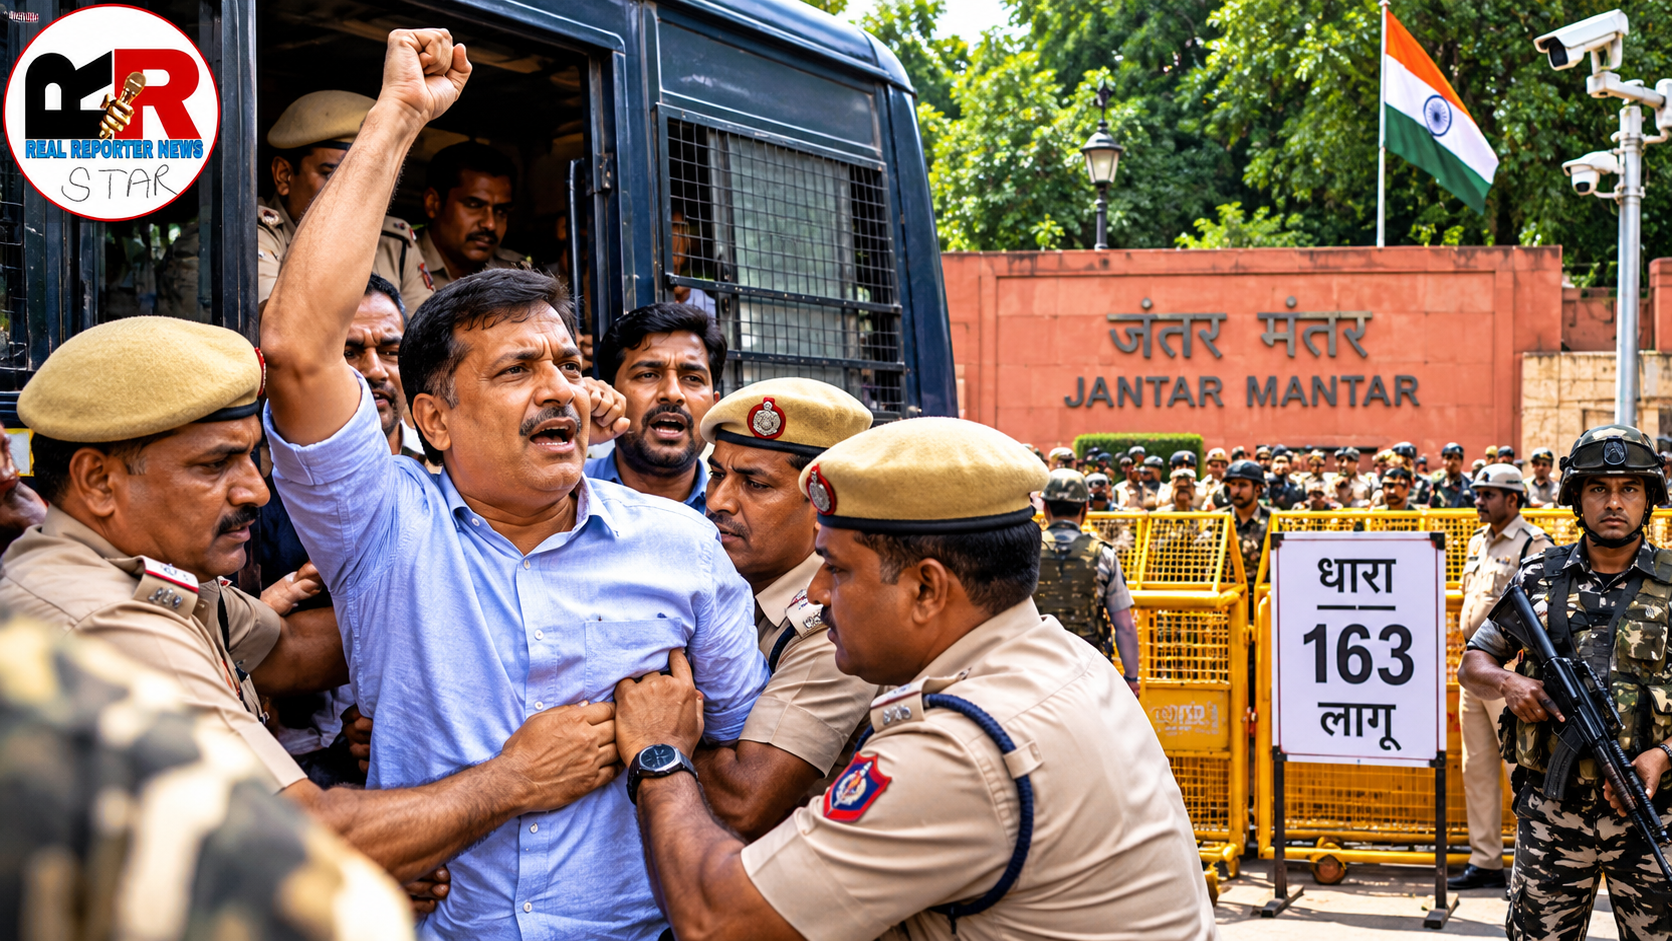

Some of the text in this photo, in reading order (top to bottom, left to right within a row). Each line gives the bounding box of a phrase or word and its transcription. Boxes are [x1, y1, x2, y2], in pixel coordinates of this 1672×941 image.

[1107, 296, 1373, 358] जंतर मंतर
[1064, 375, 1420, 408] JANTAR MANTAR
[1317, 557, 1397, 594] धारा
[1303, 623, 1415, 686] 163
[1317, 702, 1402, 752] लागू
